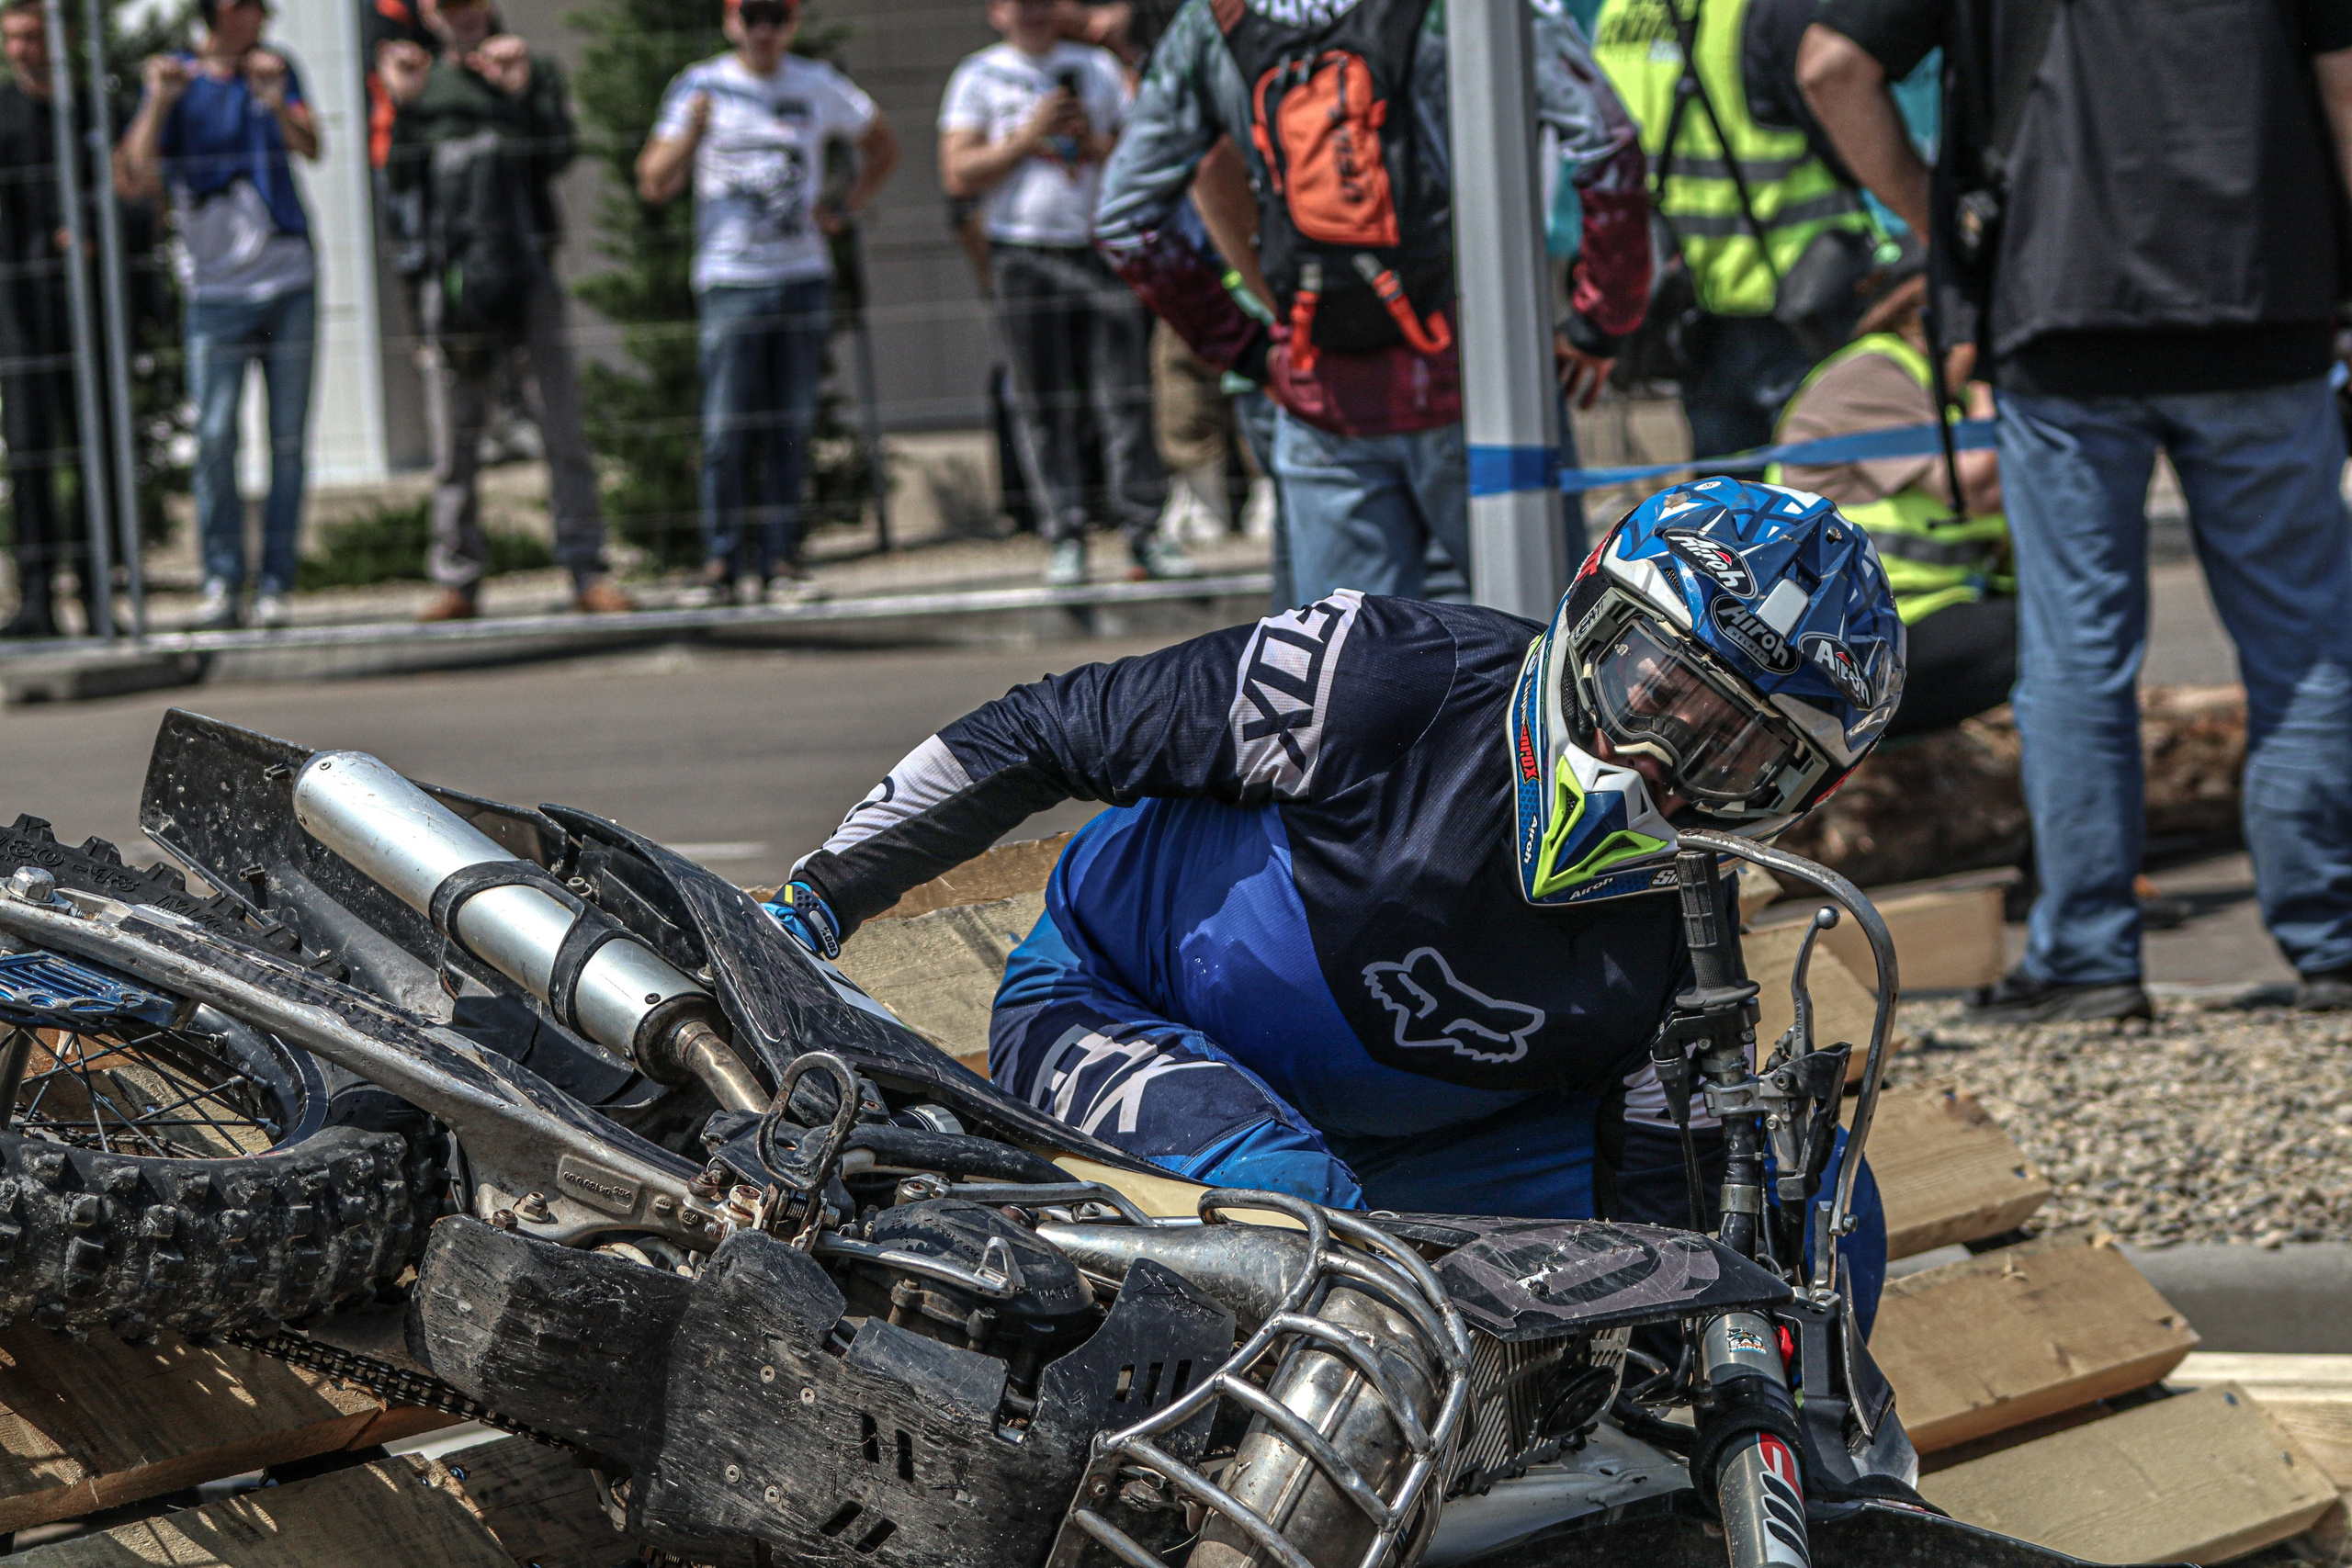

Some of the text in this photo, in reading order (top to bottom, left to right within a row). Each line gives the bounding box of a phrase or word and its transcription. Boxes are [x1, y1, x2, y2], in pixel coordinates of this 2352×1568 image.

[1668, 536, 1747, 588] Airoh
[1716, 604, 1790, 668] Airoh
[1731, 630, 1766, 660] HELMET
[1814, 639, 1871, 705] Airoh
[1522, 813, 1539, 864] Airoh
[1569, 876, 1613, 900] Airoh
[820, 926, 837, 953] 100%
[1794, 998, 1803, 1040] MAGURA
